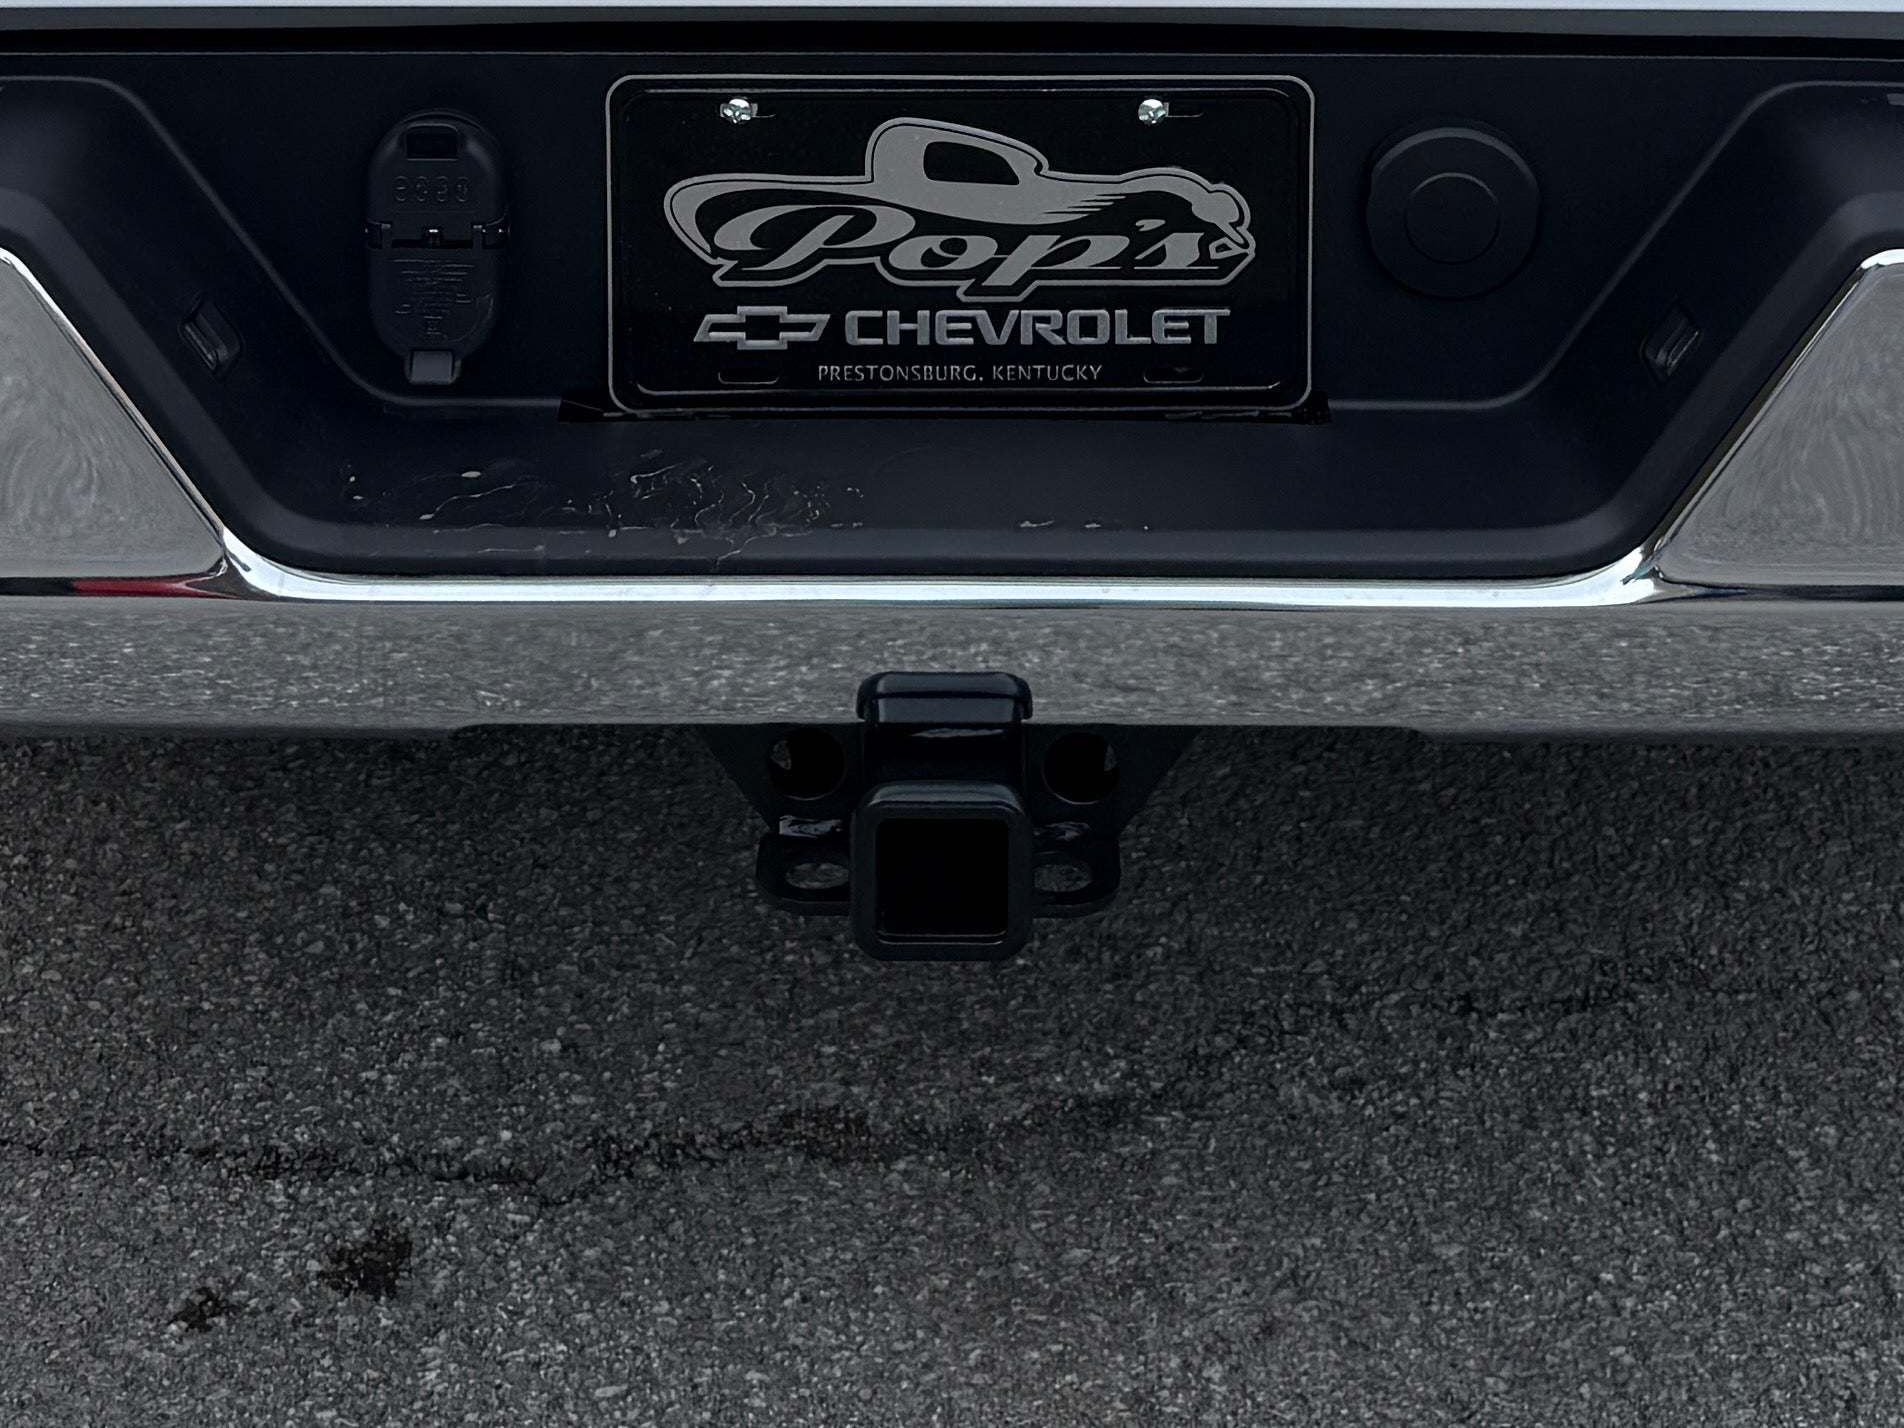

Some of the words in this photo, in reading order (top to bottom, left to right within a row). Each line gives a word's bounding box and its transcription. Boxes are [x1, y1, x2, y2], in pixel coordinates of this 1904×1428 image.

[713, 204, 1219, 287] Pop's
[845, 309, 1231, 345] CHEVROLET
[992, 363, 1102, 382] KENTUCKY
